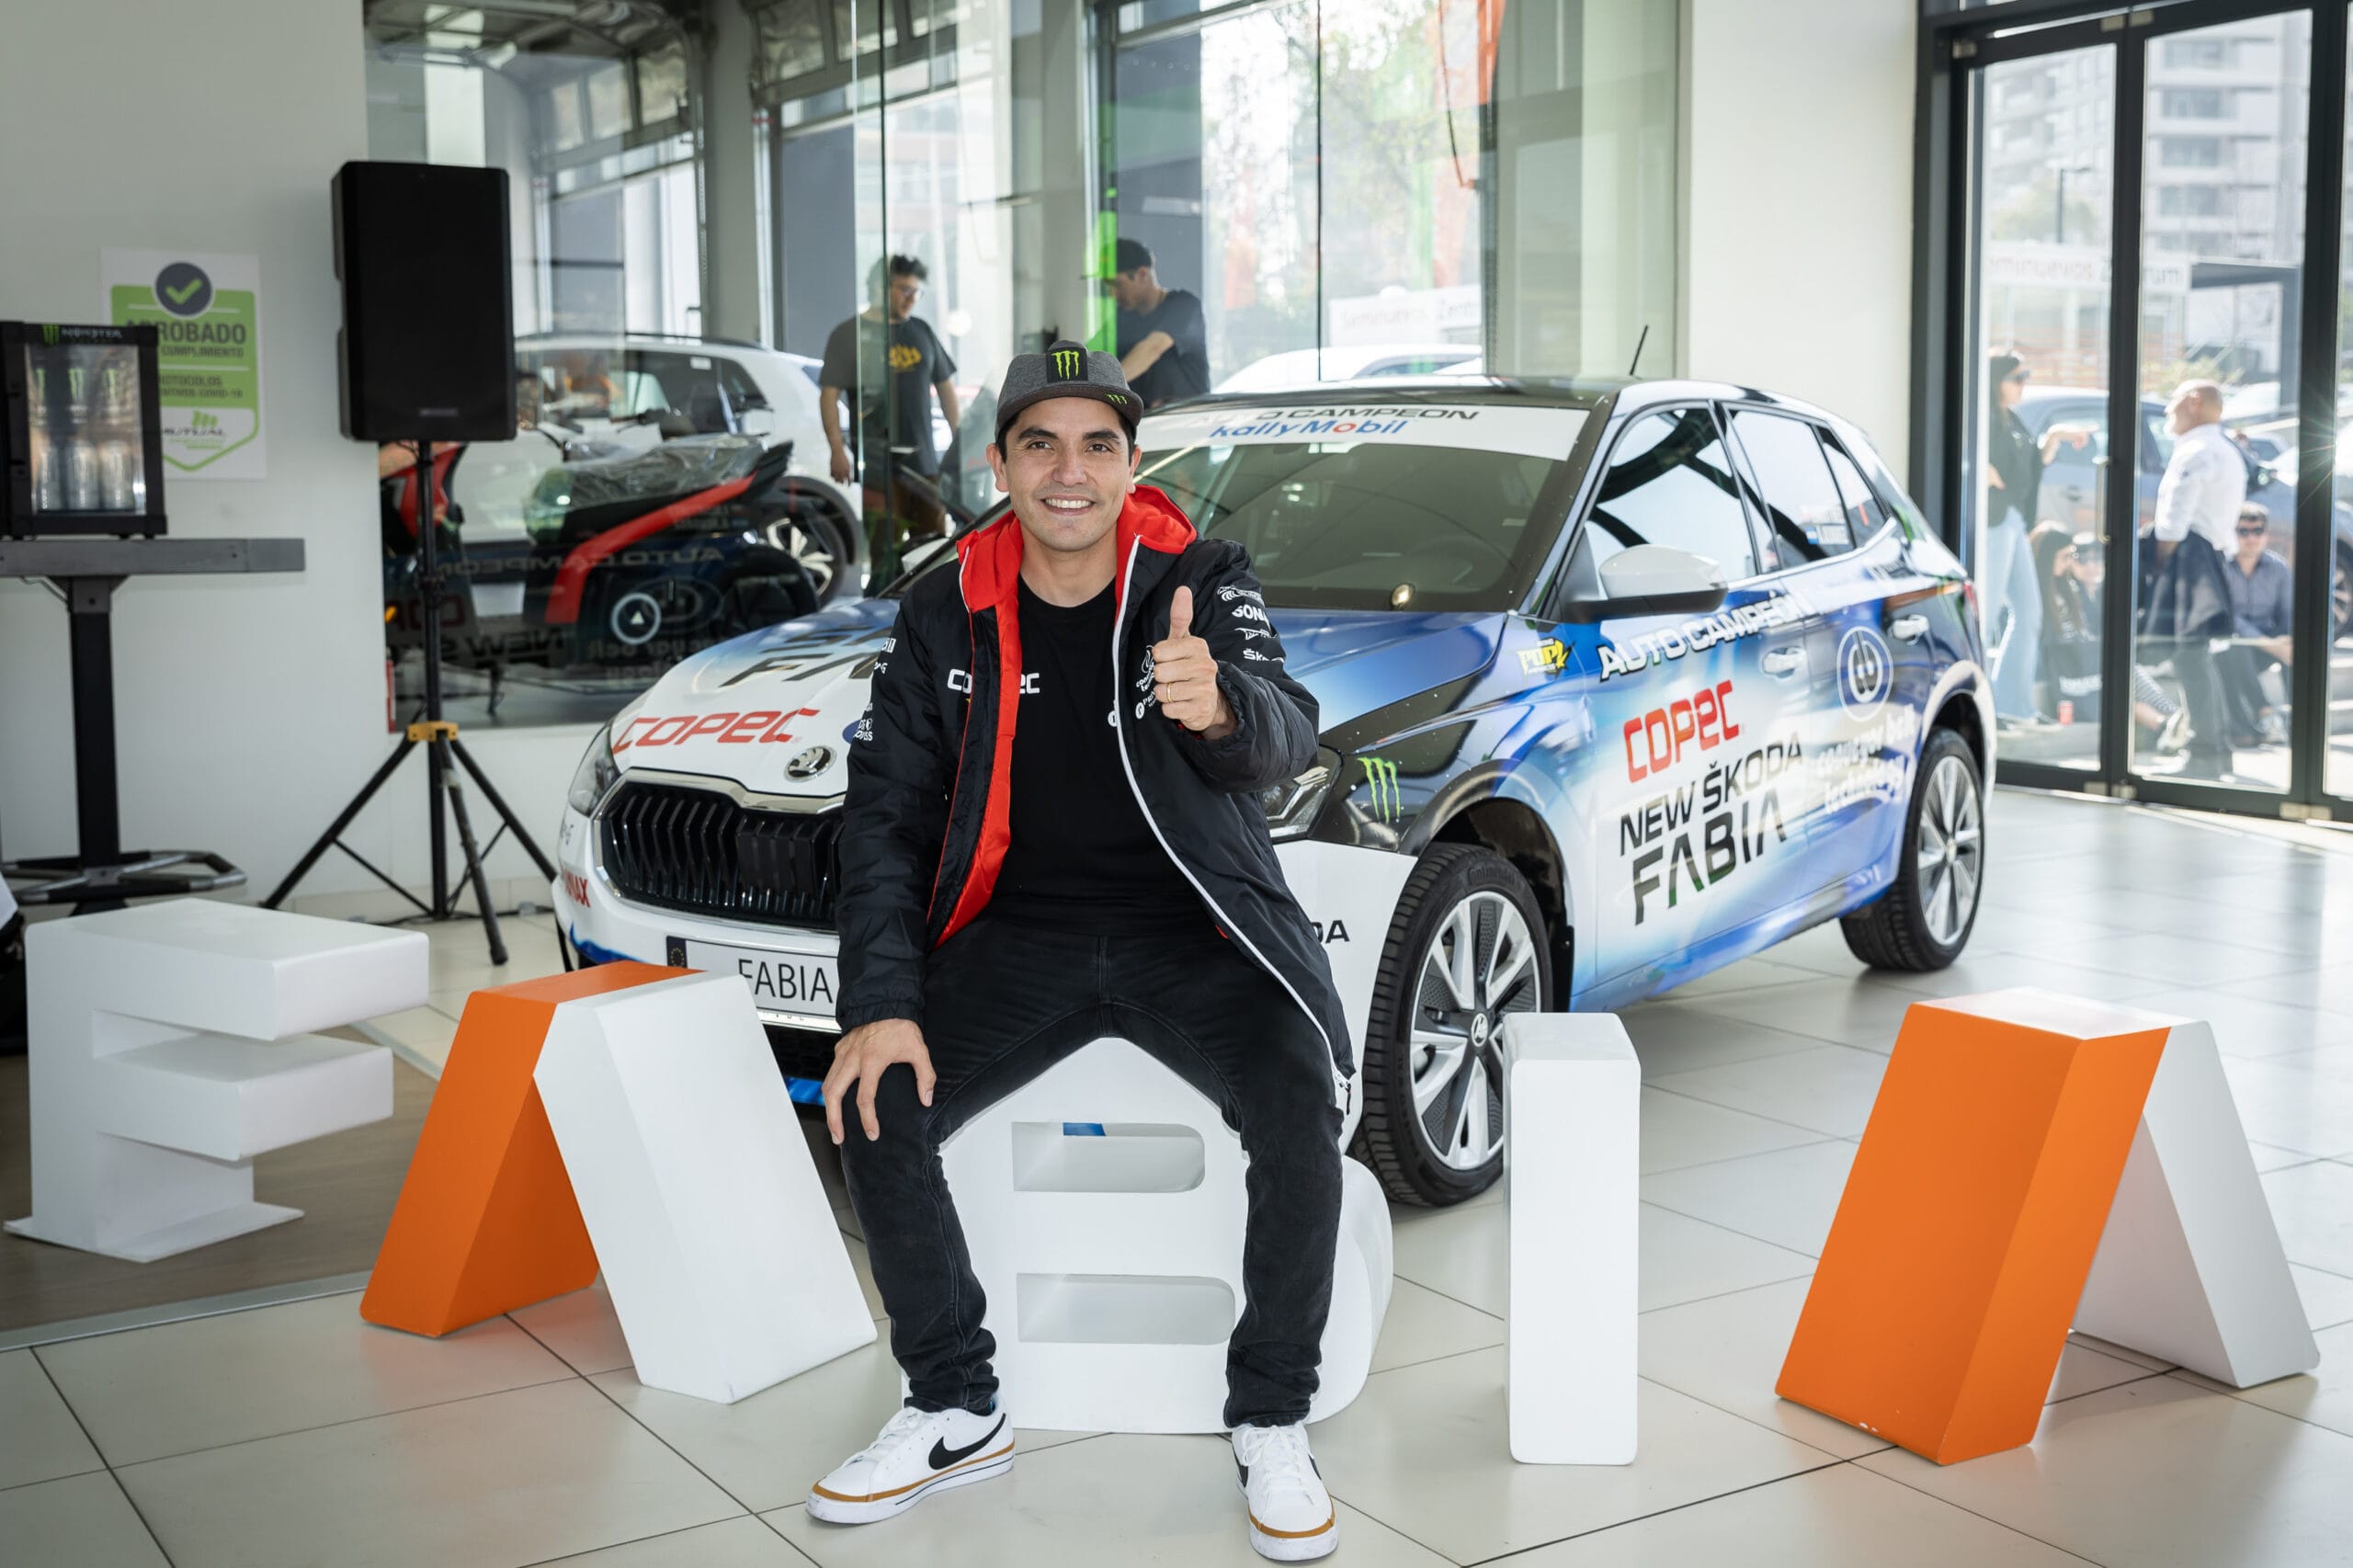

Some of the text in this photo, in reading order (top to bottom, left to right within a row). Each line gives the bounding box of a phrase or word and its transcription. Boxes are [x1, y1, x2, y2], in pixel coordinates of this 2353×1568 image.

[1287, 408, 1480, 420] CAMPEON
[1597, 627, 1688, 683] AUTO
[1623, 679, 1740, 783] COPEC
[1620, 732, 1802, 857] NEW ŠKODA
[1632, 788, 1787, 926] FABIA
[738, 958, 834, 1004] FABIA
